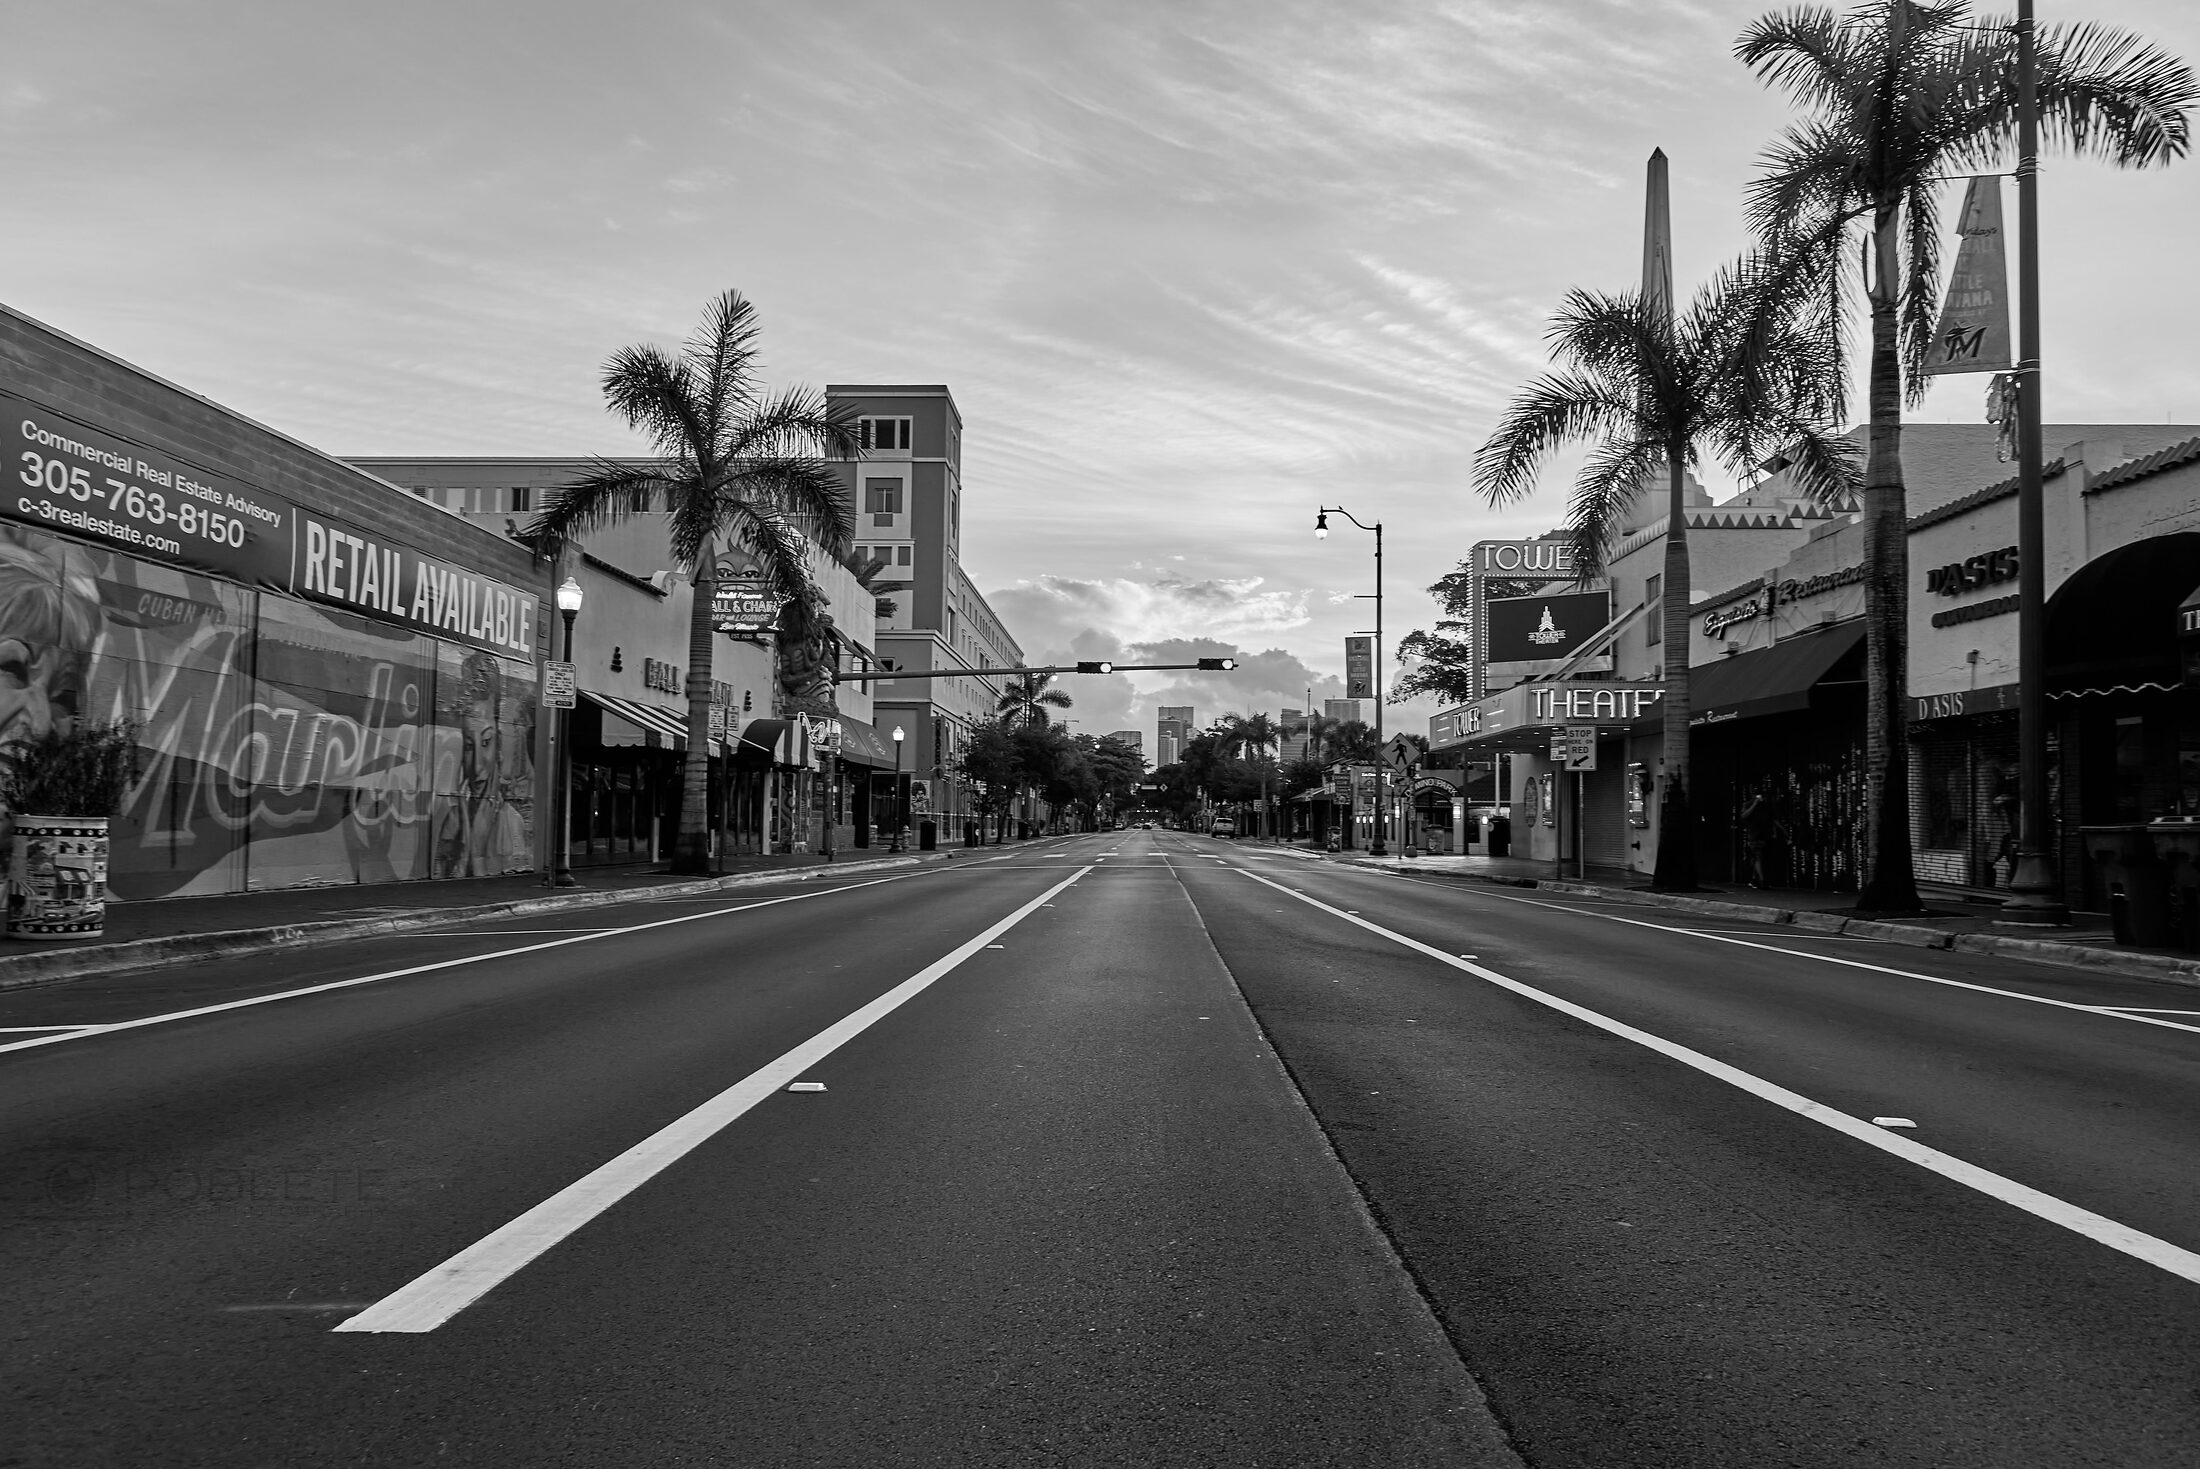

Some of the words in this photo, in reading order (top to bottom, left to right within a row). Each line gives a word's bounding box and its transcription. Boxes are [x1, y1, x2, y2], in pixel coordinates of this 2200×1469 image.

[21, 419, 132, 474] Commercial
[136, 460, 172, 488] Real
[176, 474, 222, 504] Estate
[225, 493, 281, 528] Advisory
[19, 450, 245, 548] 305-763-8150
[17, 496, 180, 555] c-3realestate.com
[1479, 544, 1574, 570] TOWE
[305, 519, 406, 617] RETAIL
[411, 561, 532, 653] AVAILABLE
[137, 593, 198, 624] CUBAN
[711, 600, 731, 613] ALL
[1530, 688, 1666, 718] THEATE
[1452, 707, 1480, 737] TOWER
[1569, 729, 1592, 737] STOP
[1404, 778, 1434, 797] DMINO
[1436, 779, 1458, 796] PARK
